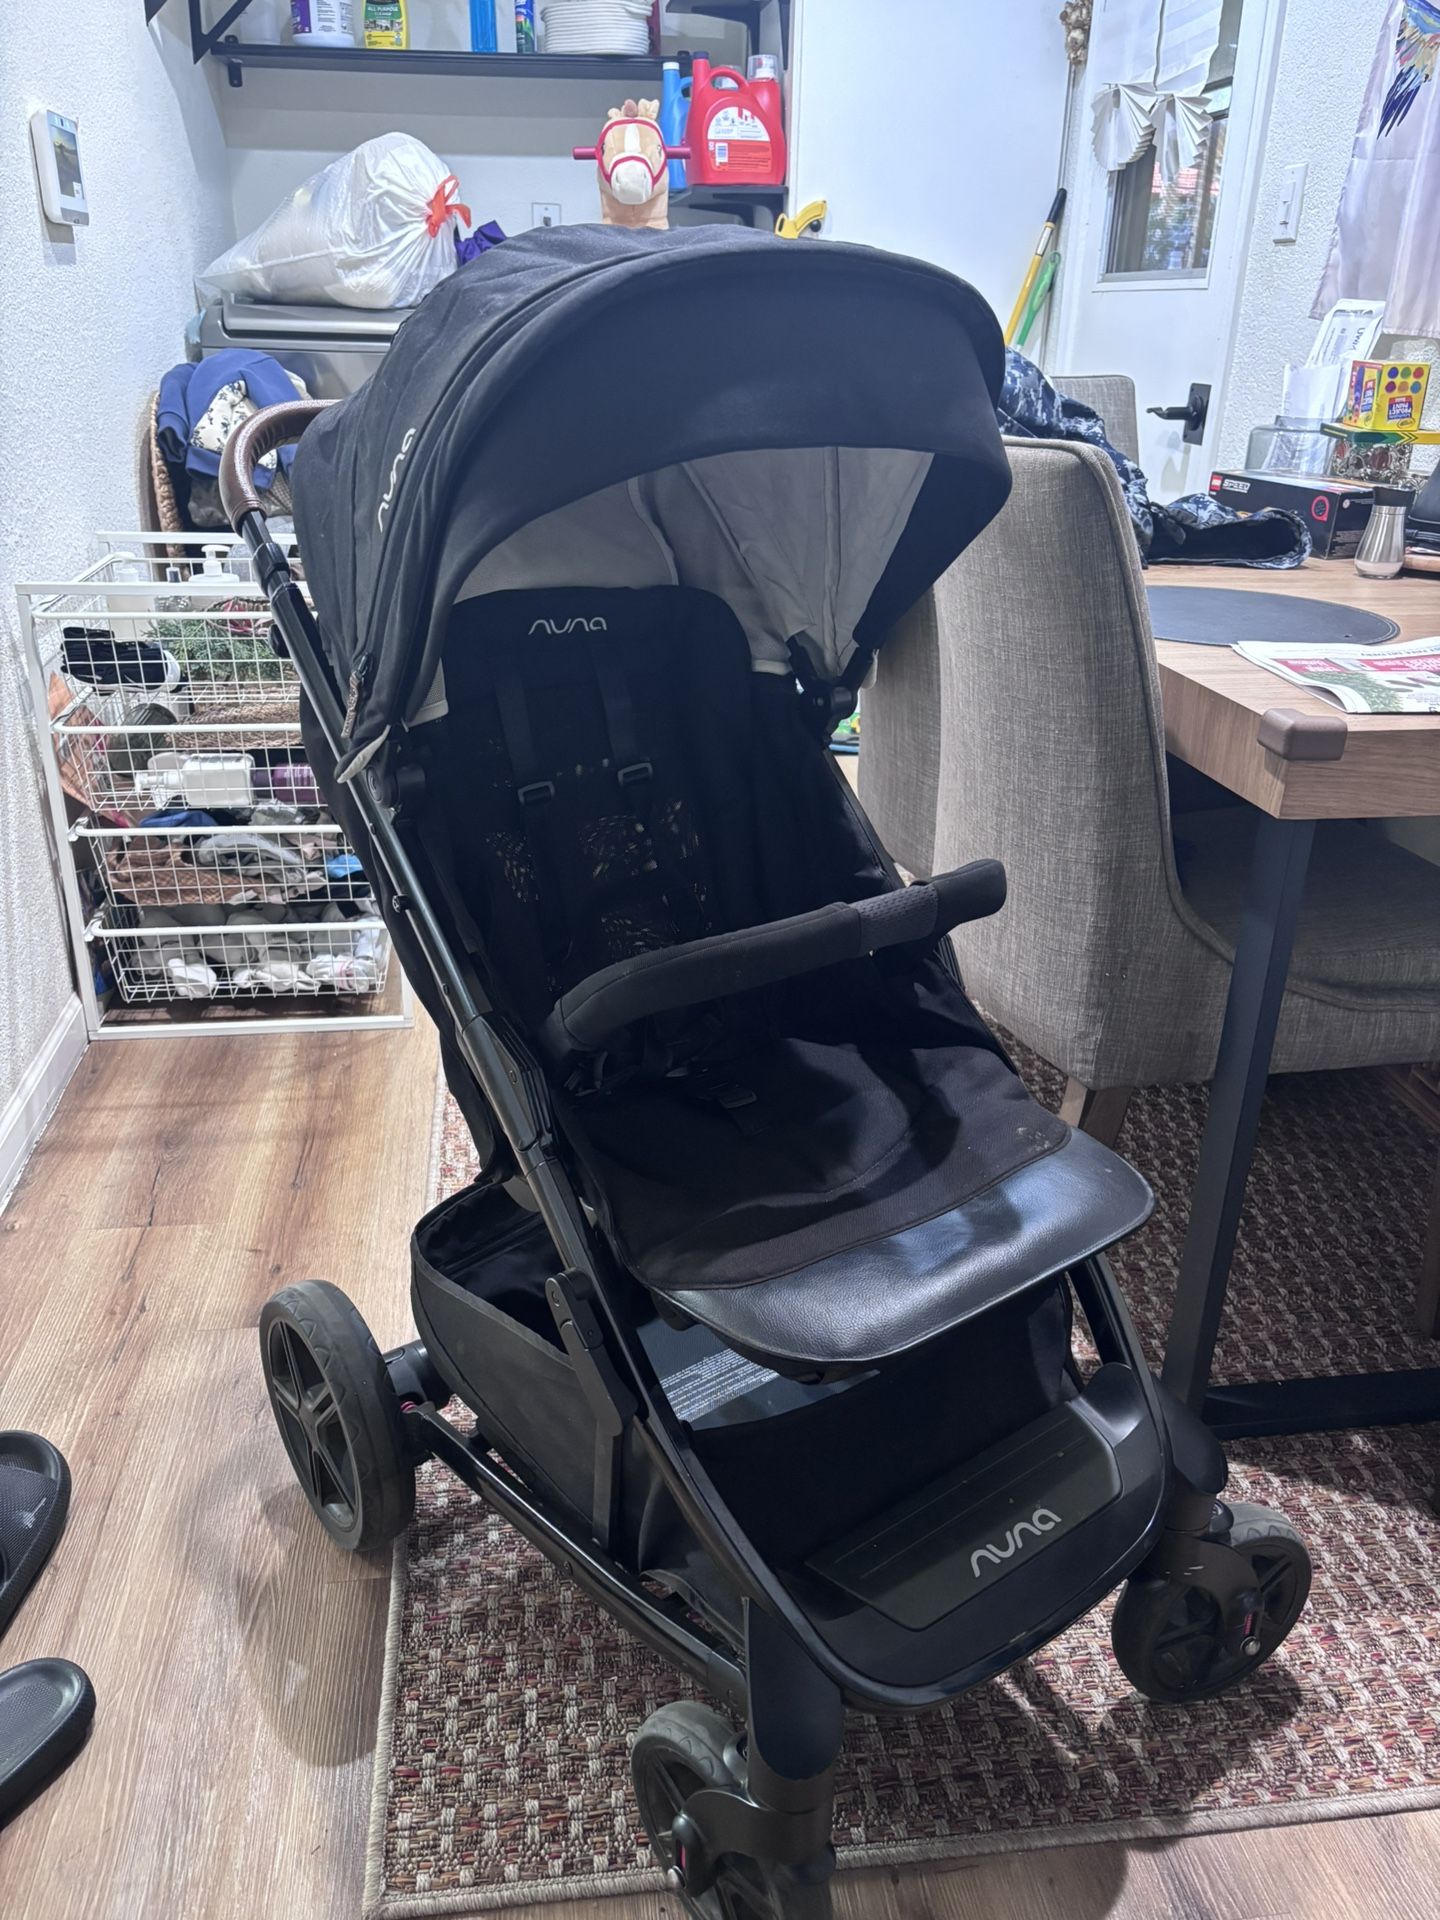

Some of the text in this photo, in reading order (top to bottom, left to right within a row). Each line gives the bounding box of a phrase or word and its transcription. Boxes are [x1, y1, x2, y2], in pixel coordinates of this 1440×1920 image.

[378, 428, 416, 532] nuna
[528, 616, 607, 635] nuna
[970, 1508, 1062, 1578] nuna
